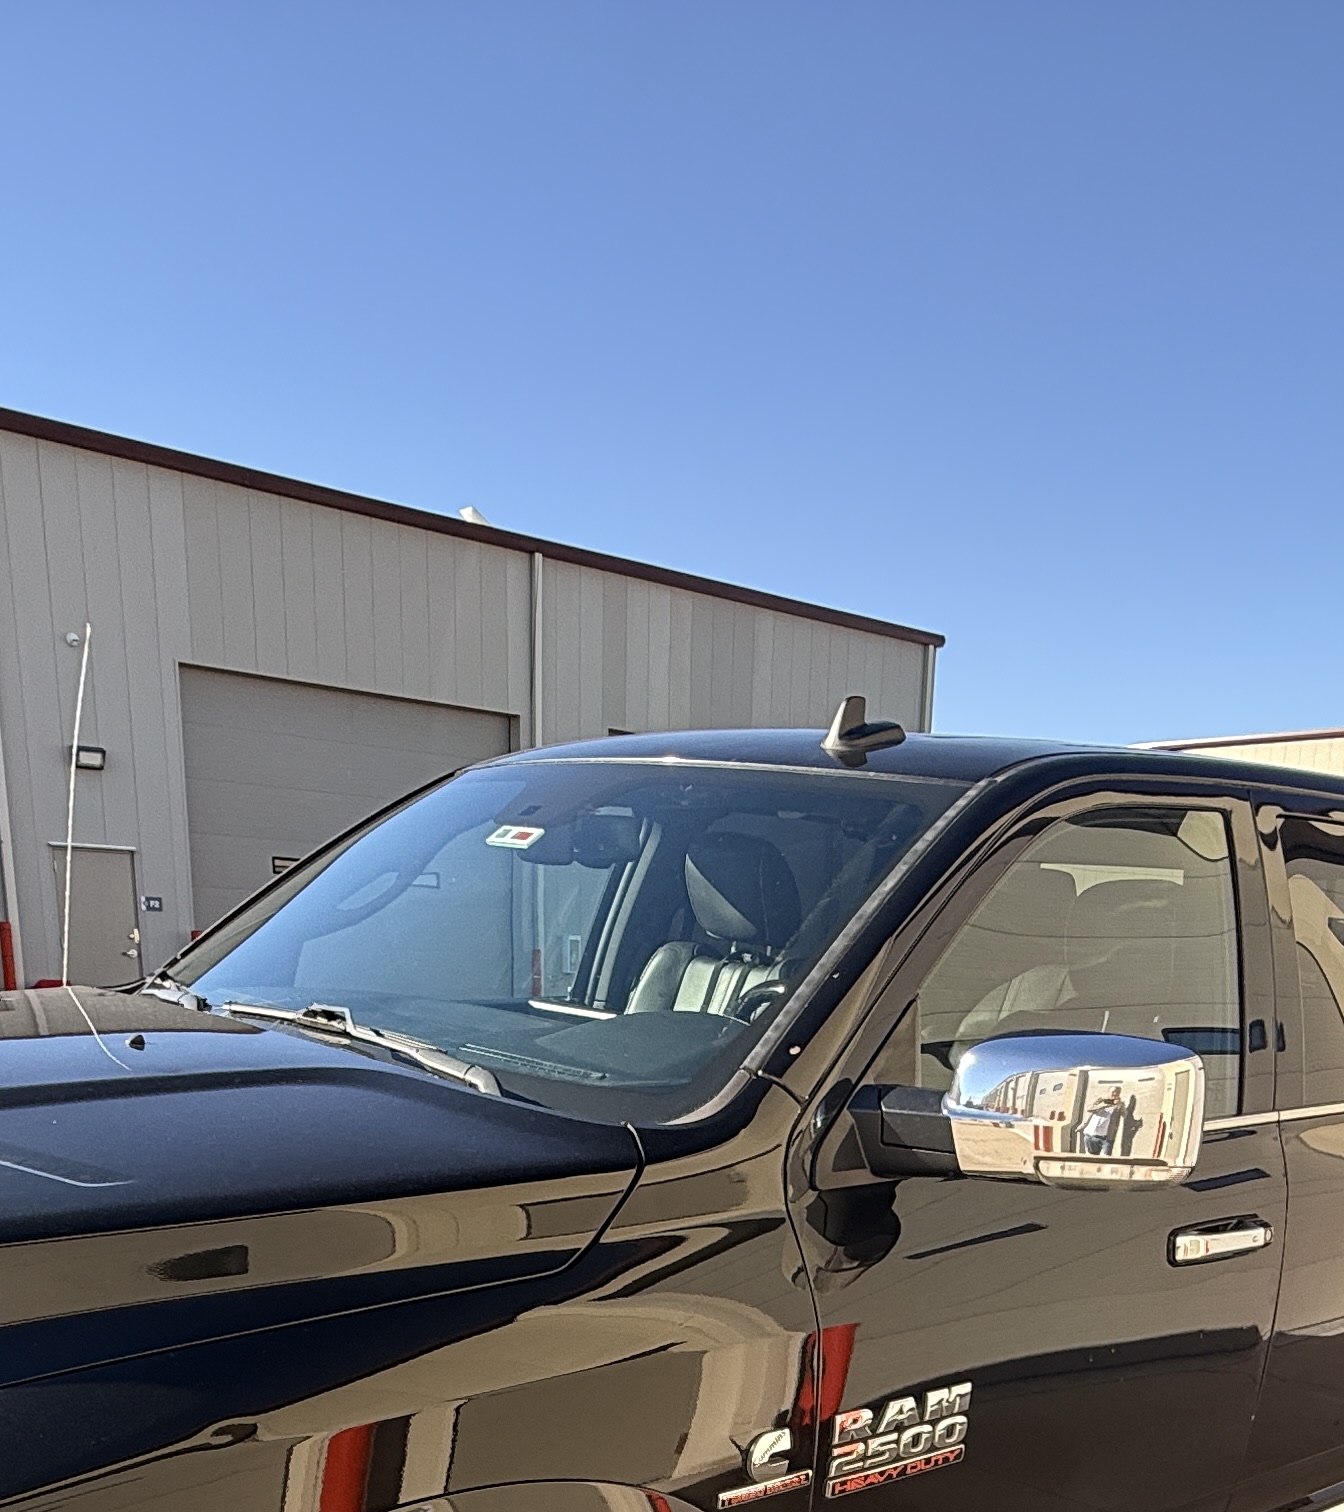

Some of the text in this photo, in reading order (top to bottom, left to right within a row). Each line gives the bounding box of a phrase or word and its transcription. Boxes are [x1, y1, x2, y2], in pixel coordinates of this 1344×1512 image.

[149, 900, 161, 909] F2
[831, 1380, 973, 1444] RAM
[829, 1415, 970, 1477] 2500
[834, 1449, 961, 1495] HEAVY DUTY
